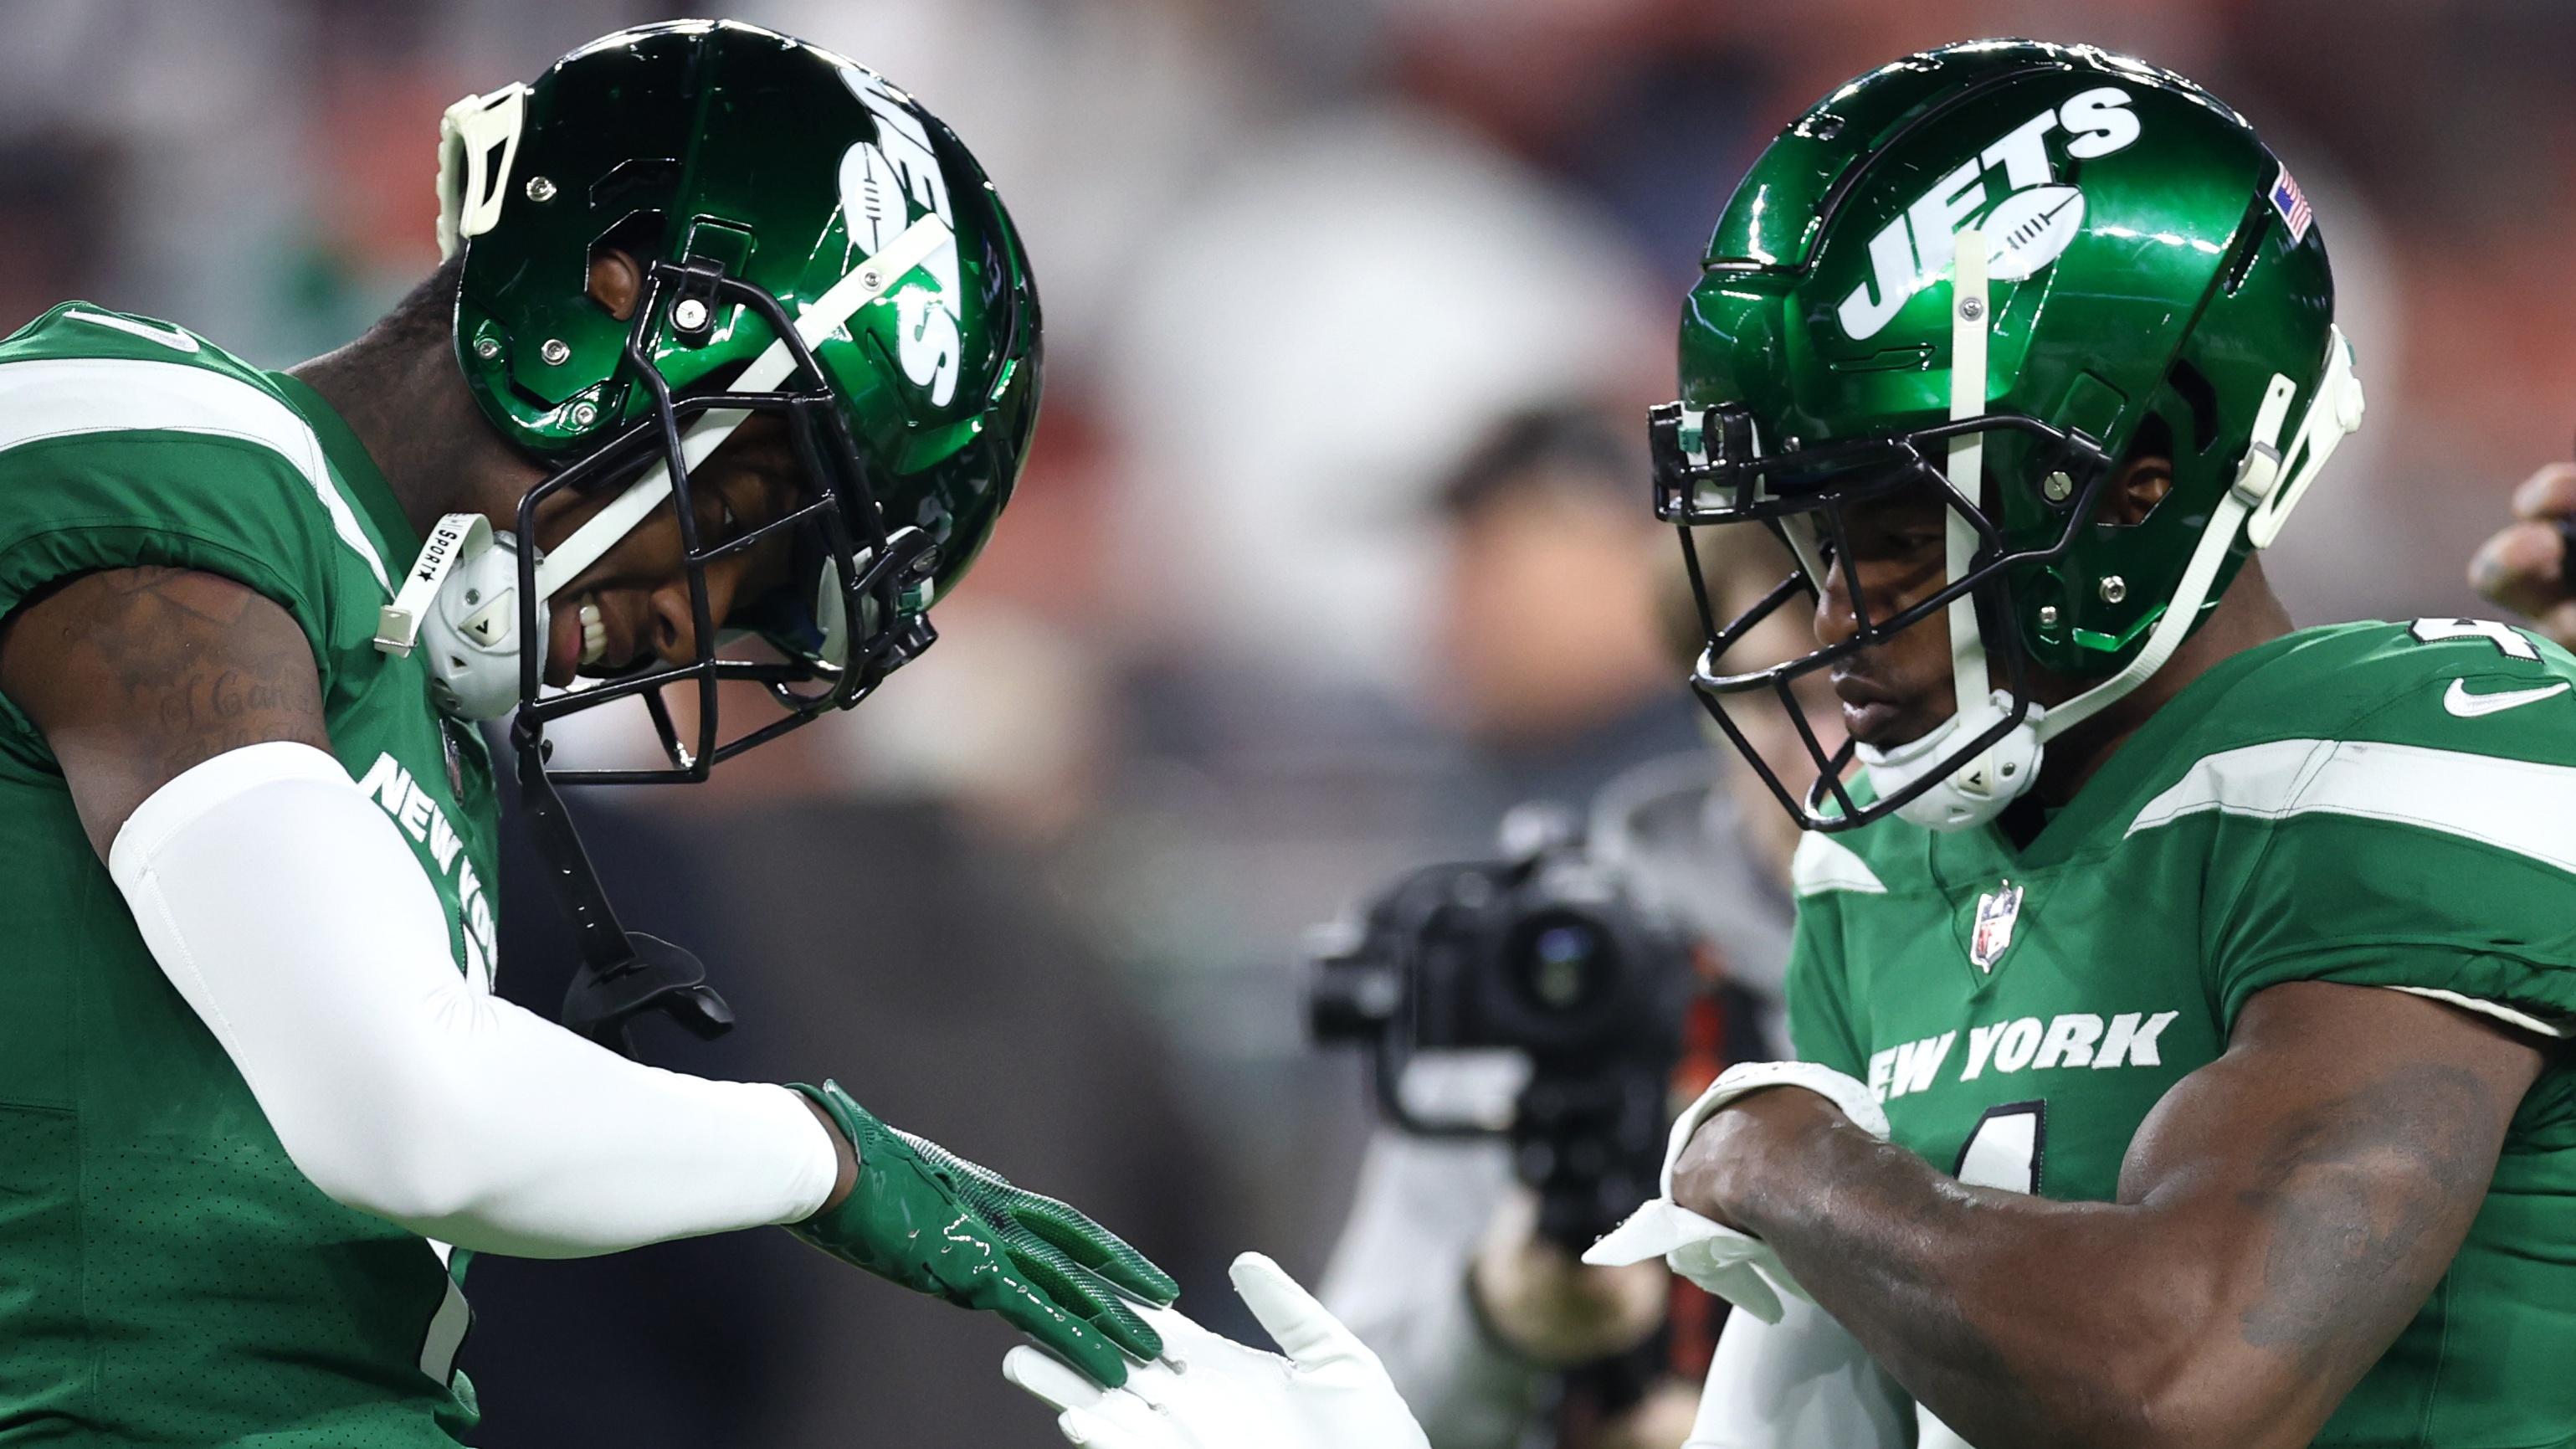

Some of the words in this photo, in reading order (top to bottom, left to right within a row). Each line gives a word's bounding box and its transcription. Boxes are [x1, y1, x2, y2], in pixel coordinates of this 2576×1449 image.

[1837, 86, 2142, 341] JETS
[421, 529, 458, 573] SPORT
[357, 751, 464, 876] NEW
[1868, 1030, 1957, 1104] EW
[1960, 1010, 2179, 1082] YORK
